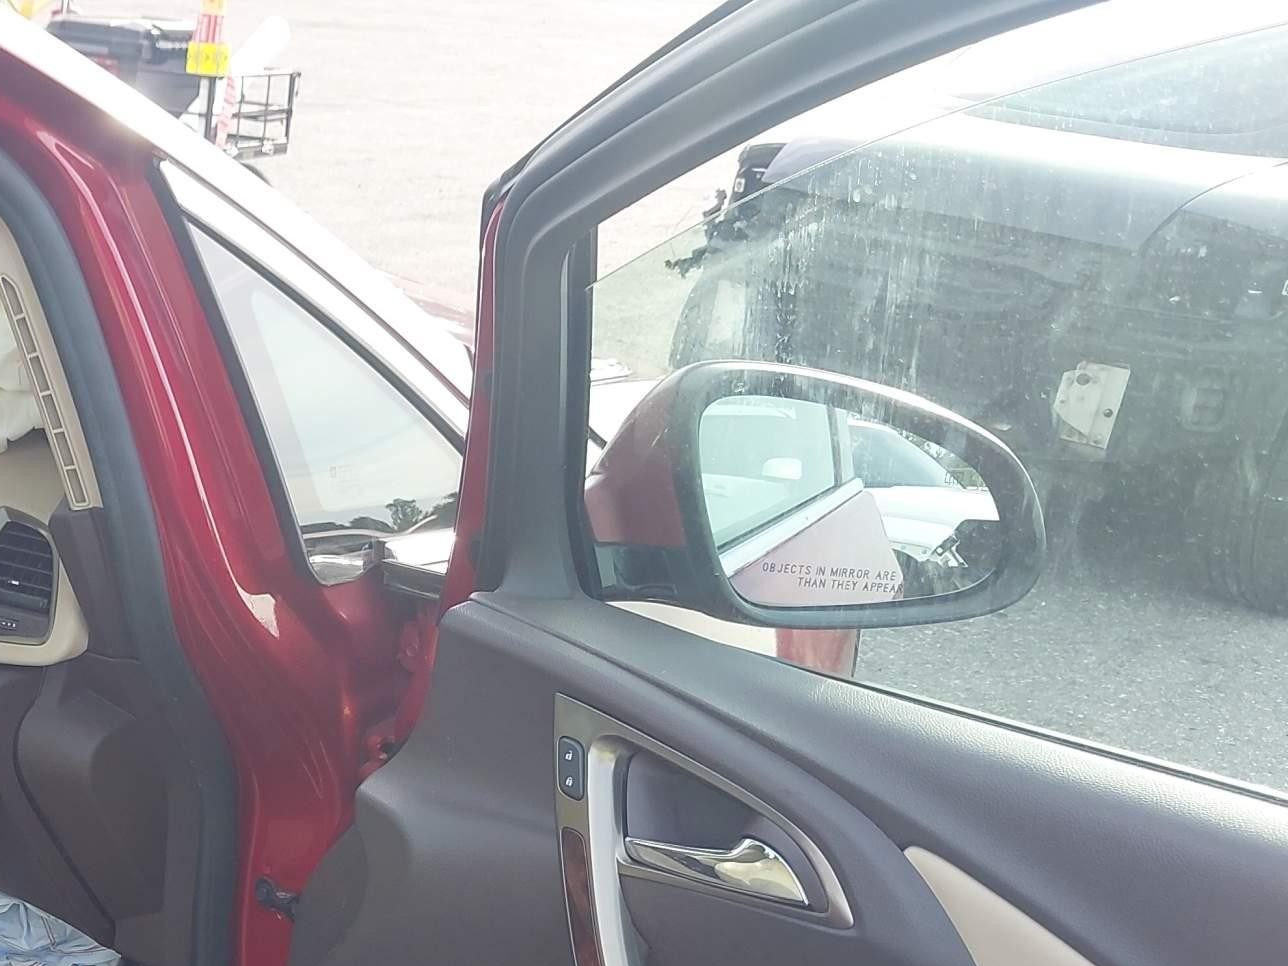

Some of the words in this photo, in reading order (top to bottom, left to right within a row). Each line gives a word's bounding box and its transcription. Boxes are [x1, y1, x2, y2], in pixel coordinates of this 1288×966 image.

[762, 562, 811, 576] OBJECTS
[816, 566, 826, 577] IN
[830, 567, 870, 580] MIRROR
[875, 570, 897, 581] ARE
[798, 577, 826, 589] THAN
[832, 579, 858, 591] THEY
[862, 582, 904, 594] APPEAR
